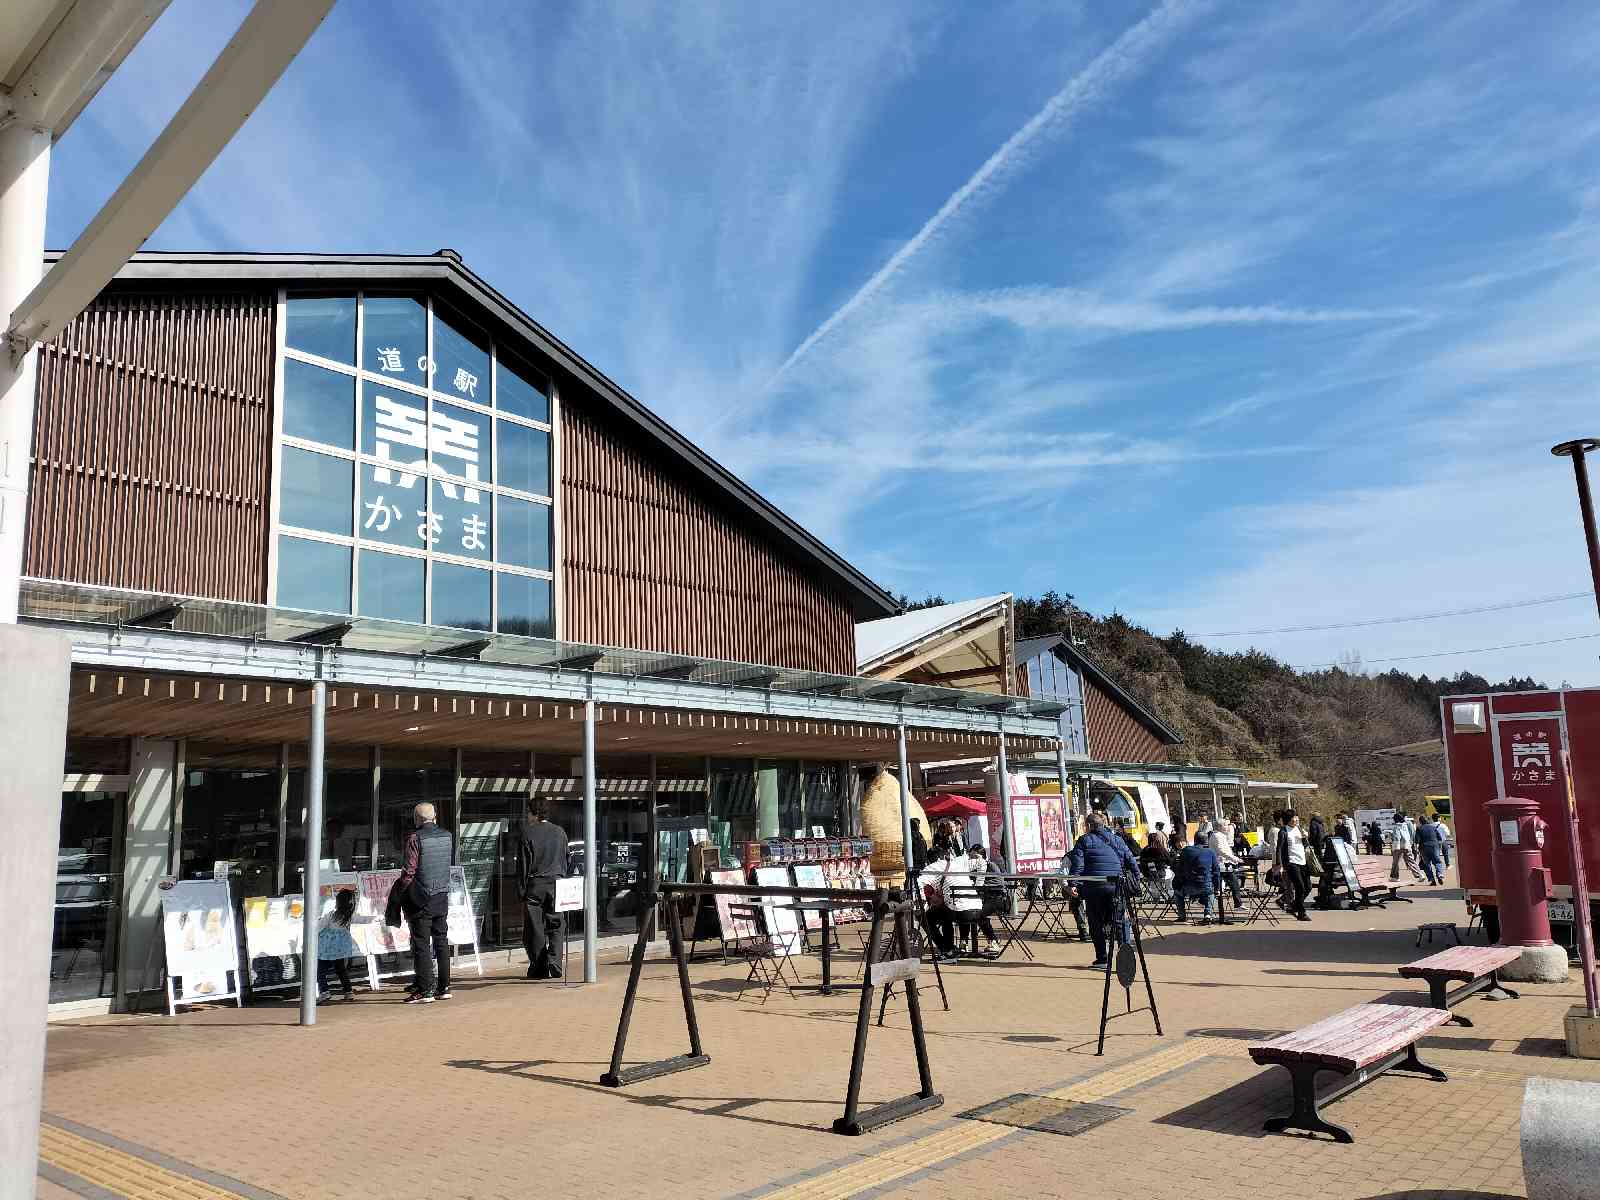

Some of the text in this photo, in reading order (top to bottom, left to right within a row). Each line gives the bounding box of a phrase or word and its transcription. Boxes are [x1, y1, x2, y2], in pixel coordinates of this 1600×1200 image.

[376, 346, 479, 398] 道の駅
[364, 495, 487, 551] かさま
[1511, 769, 1556, 781] かさま
